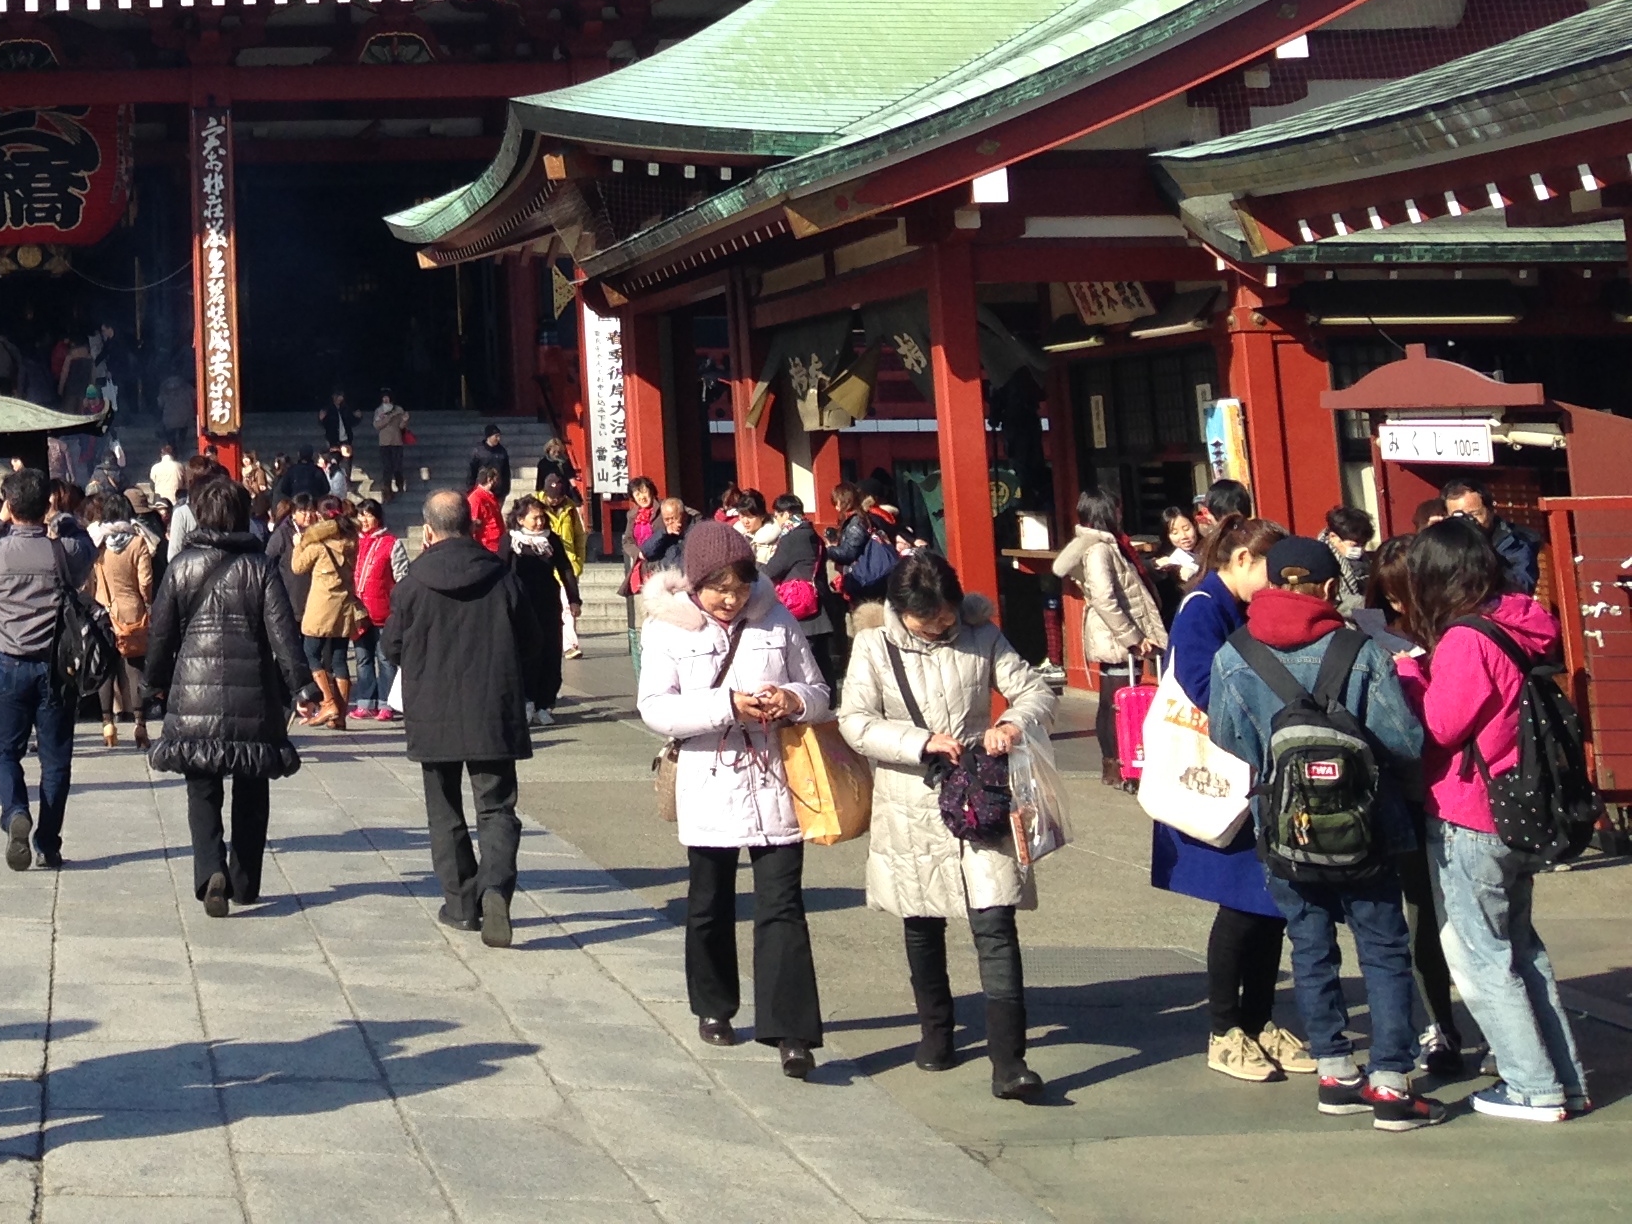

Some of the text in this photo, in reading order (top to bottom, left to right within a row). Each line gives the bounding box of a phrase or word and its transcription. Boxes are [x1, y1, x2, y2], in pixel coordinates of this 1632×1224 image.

[1388, 430, 1481, 458] みくじ 100円
